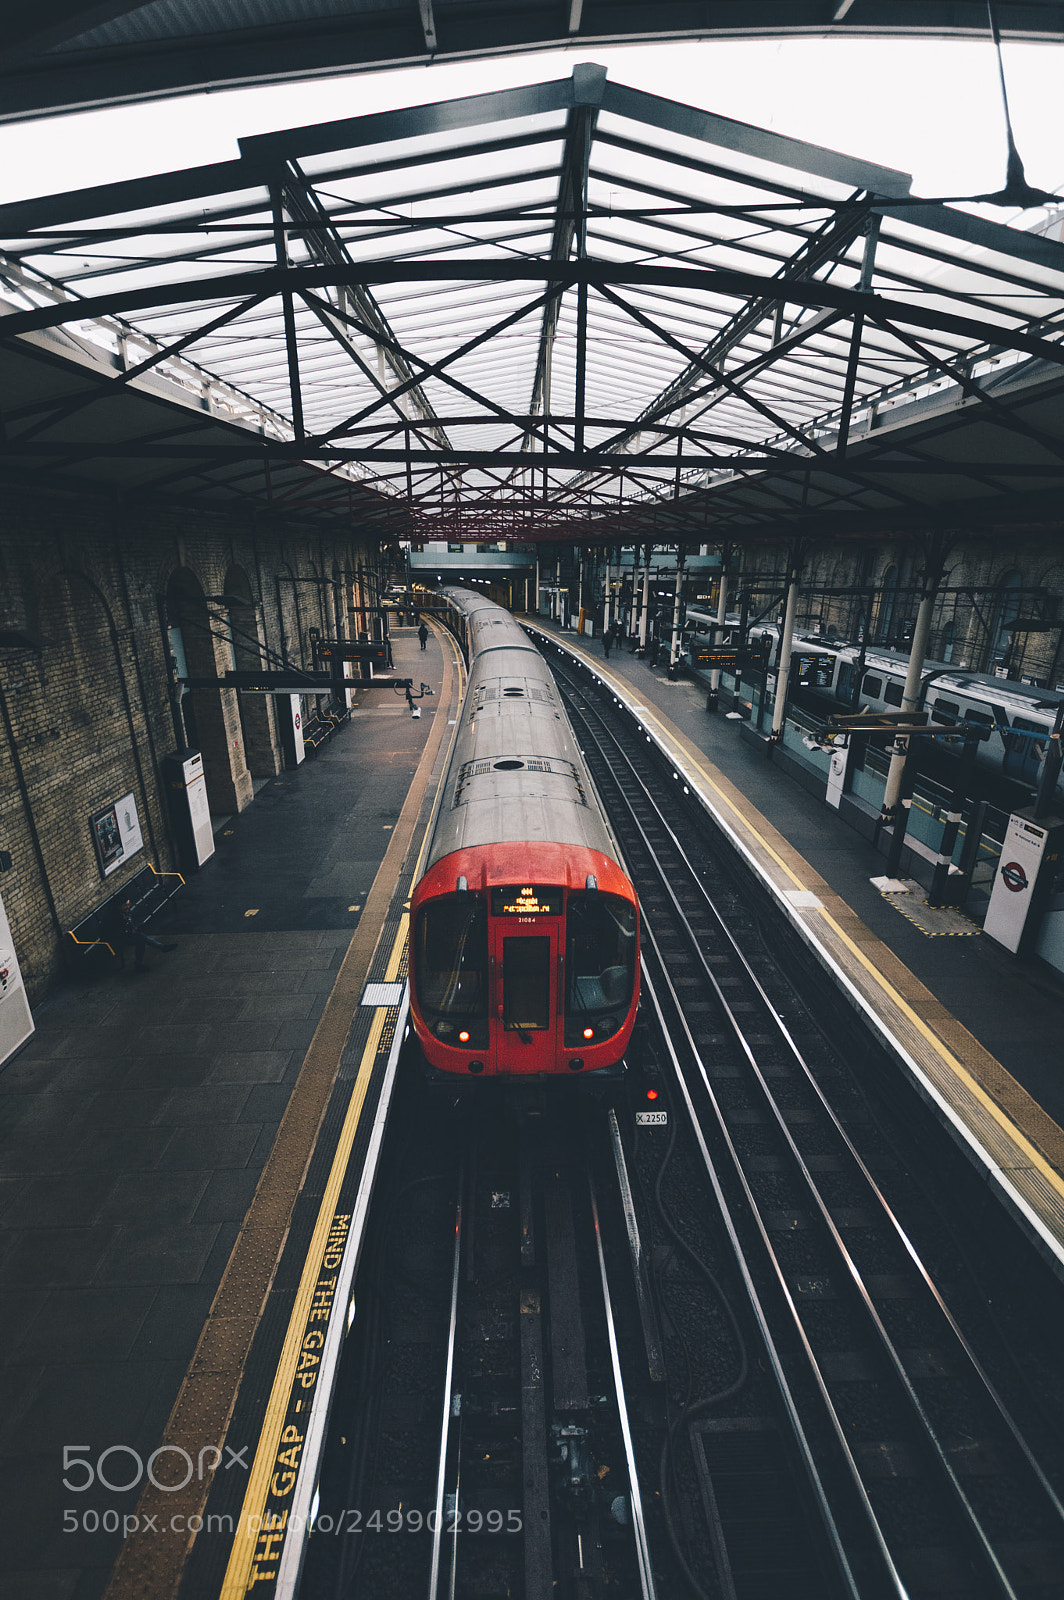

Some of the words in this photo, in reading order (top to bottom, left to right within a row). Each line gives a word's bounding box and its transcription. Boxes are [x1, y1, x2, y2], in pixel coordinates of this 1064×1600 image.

[323, 1214, 351, 1269] MIND
[309, 1275, 337, 1322] THE
[295, 1330, 325, 1389] GAP
[246, 1509, 289, 1591] THE
[271, 1424, 304, 1497] GAP
